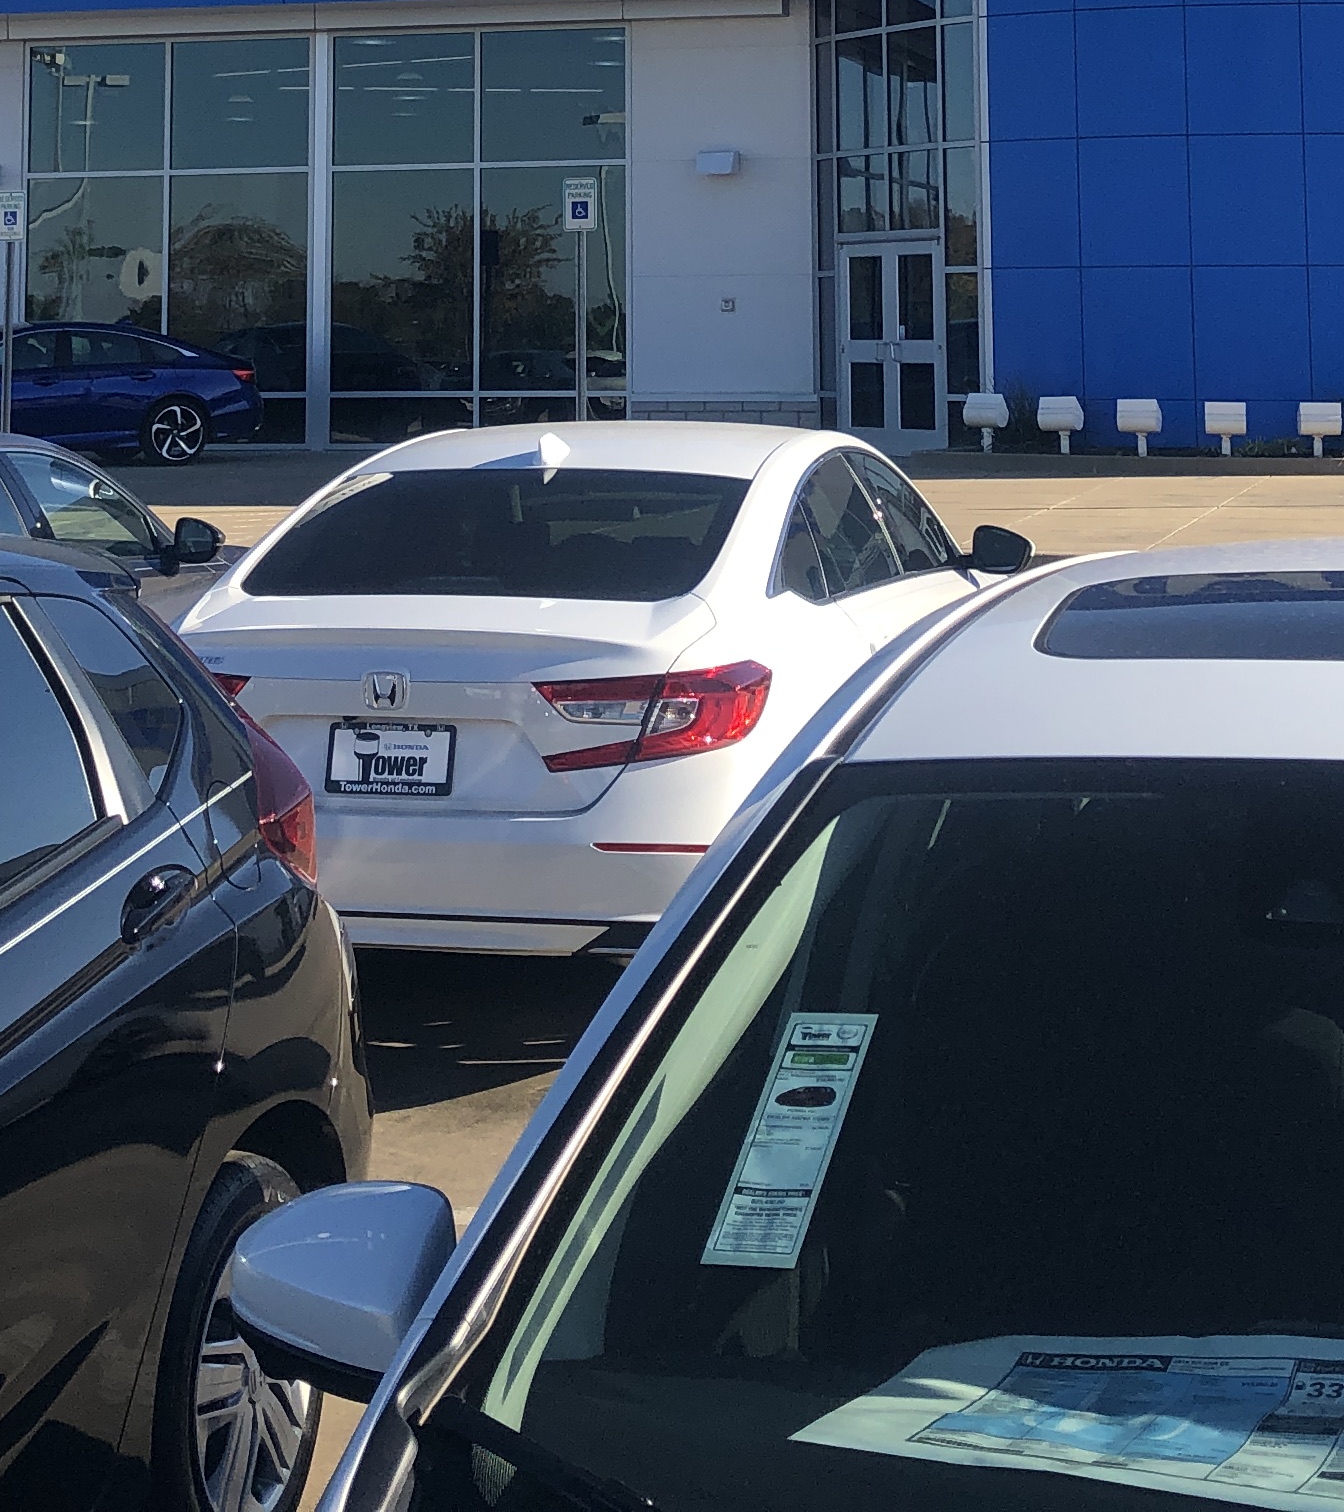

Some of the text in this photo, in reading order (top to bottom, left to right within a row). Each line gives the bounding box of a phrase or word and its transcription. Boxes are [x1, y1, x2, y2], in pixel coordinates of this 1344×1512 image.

[340, 781, 436, 794] TowerHonda.com
[1050, 1355, 1165, 1369] HONDA
[1306, 1381, 1344, 1399] 33
